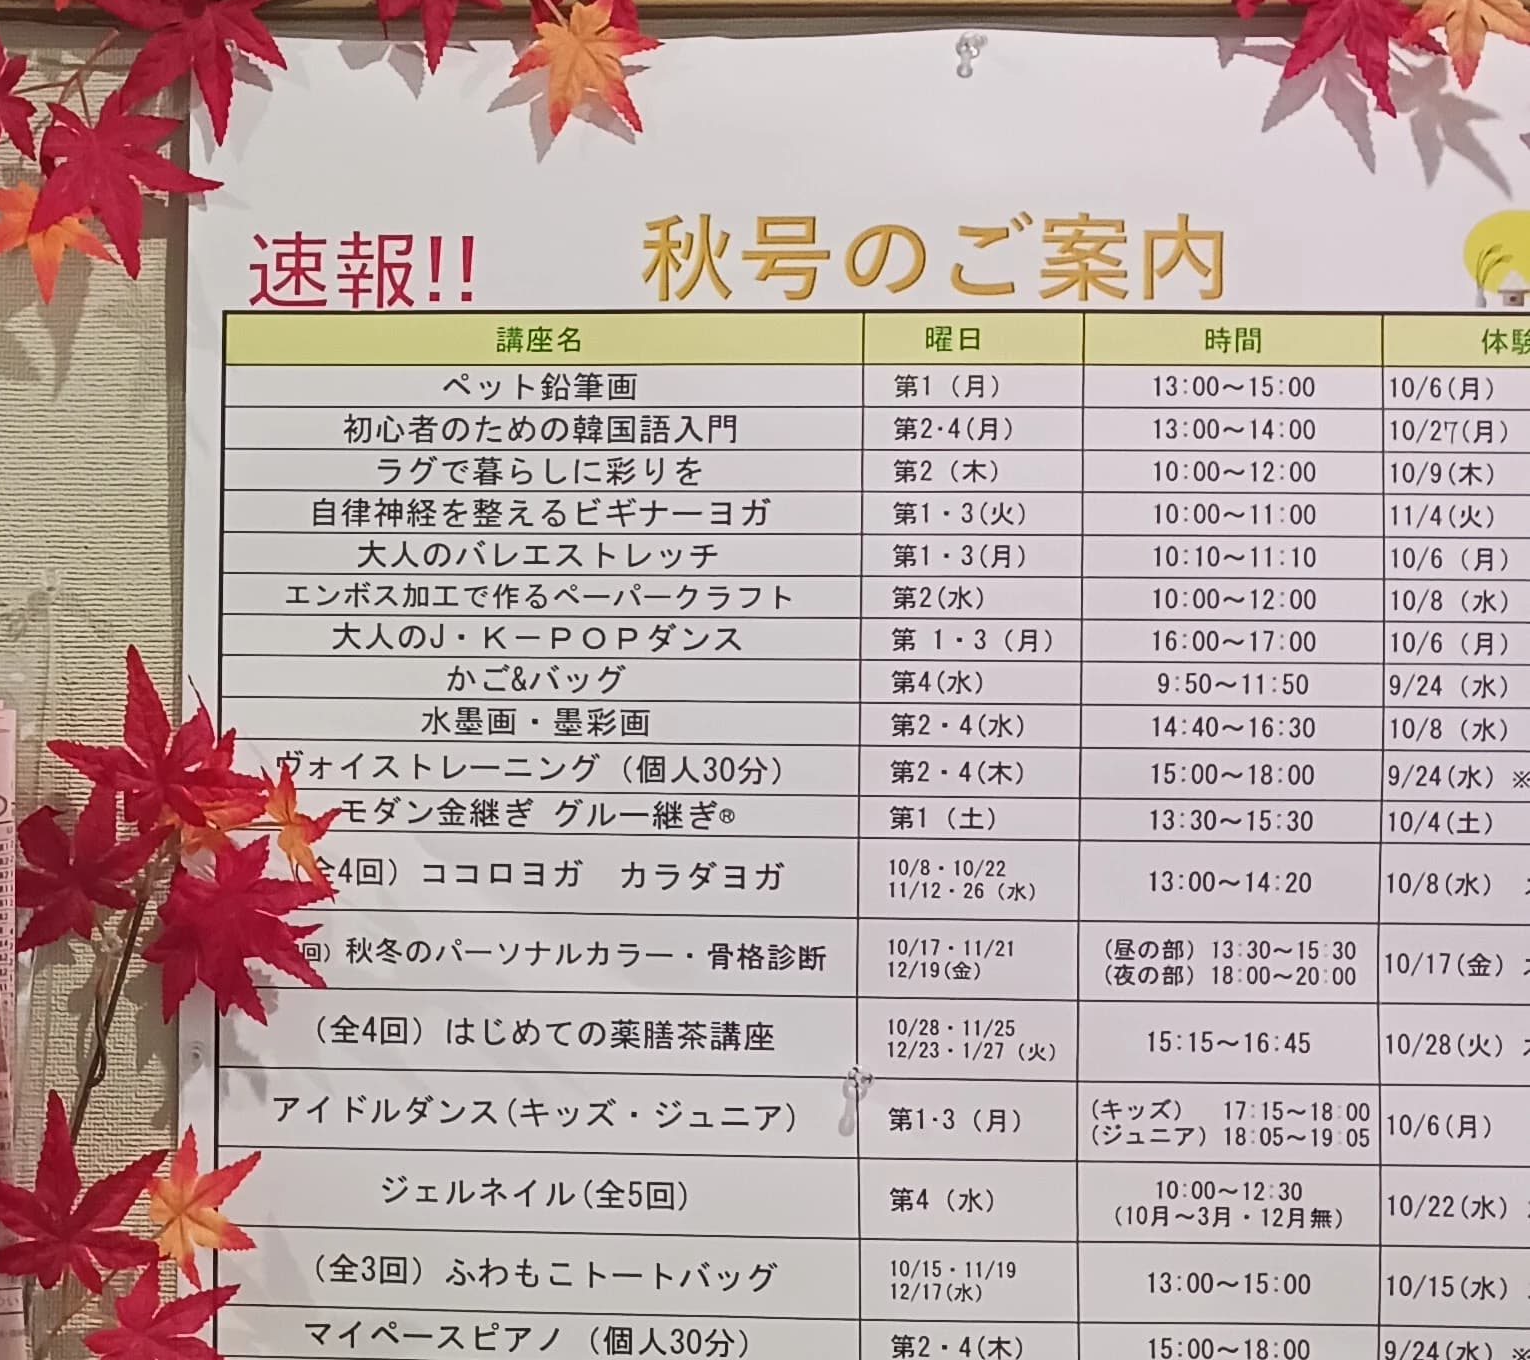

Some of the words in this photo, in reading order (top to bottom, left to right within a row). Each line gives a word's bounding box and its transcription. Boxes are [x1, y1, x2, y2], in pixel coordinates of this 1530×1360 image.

[248, 230, 475, 309] 速報!!
[639, 211, 1226, 303] 秋号のご案内
[496, 325, 581, 354] 講座名
[925, 325, 981, 353] 曜日
[1204, 326, 1262, 355] 時間
[442, 371, 638, 402] ペット鉛筆画
[1389, 375, 1494, 401] 10/6(月）
[343, 412, 737, 445] 初心者のための韓国語入門
[1389, 418, 1508, 445] 10/27(月）
[377, 455, 703, 487] ラグで暮らしに彩りを
[893, 458, 999, 484] 第2（木）
[1390, 460, 1494, 487] 10/9(木）
[312, 496, 772, 528] 自律神経を整えるビギナーヨガ
[892, 501, 1026, 526] 第1・3(火）
[1390, 503, 1495, 529] 11/4(火）
[357, 539, 719, 570] 大人のバレエストレッチ
[892, 543, 1026, 569] 第1・3(月）
[1391, 546, 1509, 572] 10/6（月）
[285, 580, 792, 611] エンボス加工で作るペーパークラフト
[891, 585, 984, 611] 第2(水）
[1391, 588, 1509, 615] 10/8（水）
[1391, 630, 1508, 657] 10/6（月）
[446, 663, 627, 695] かご&バッグ
[890, 669, 983, 695] 第4(水）
[1389, 673, 1508, 700] 9/24（水）
[420, 705, 651, 738] 水墨画・墨彩画
[890, 712, 1025, 739] 第2・4(水）
[1390, 716, 1508, 743] 10/8（水）
[273, 751, 784, 785] ヴォイストレーニング（個人30分）
[889, 759, 1024, 786] 第2・4(木）
[340, 797, 534, 828] モダン金継ぎ
[889, 805, 996, 831] 第1（土）
[1388, 809, 1493, 836] 10/4(土）
[620, 860, 786, 891] カラダヨガ
[889, 858, 1007, 879] 10/8・10/22
[1386, 871, 1492, 897] 10/8(水）
[888, 937, 1014, 960] 10/17・11/21
[887, 960, 981, 981] 12/19(金）
[1384, 951, 1504, 978] 10/17(金）
[888, 1017, 1016, 1039] 10/28・11/25
[1385, 1031, 1503, 1059] 10/28(火）
[272, 1094, 796, 1134] アイドルダンス(キッズ・ジュニア）
[1386, 1113, 1492, 1140] 10/6(月）
[381, 1175, 688, 1212] ジェルネイル(全5回）
[889, 1186, 994, 1214] 第4（水）
[1387, 1193, 1508, 1221] 10/22(水）
[890, 1259, 1017, 1281] 10/15・11/19
[890, 1281, 983, 1304] 12/17(水）
[1386, 1273, 1508, 1301] 10/15(水）
[304, 1320, 749, 1359] マイペースピアノ（個人30分）
[890, 1333, 1023, 1360] 第2・4(木）
